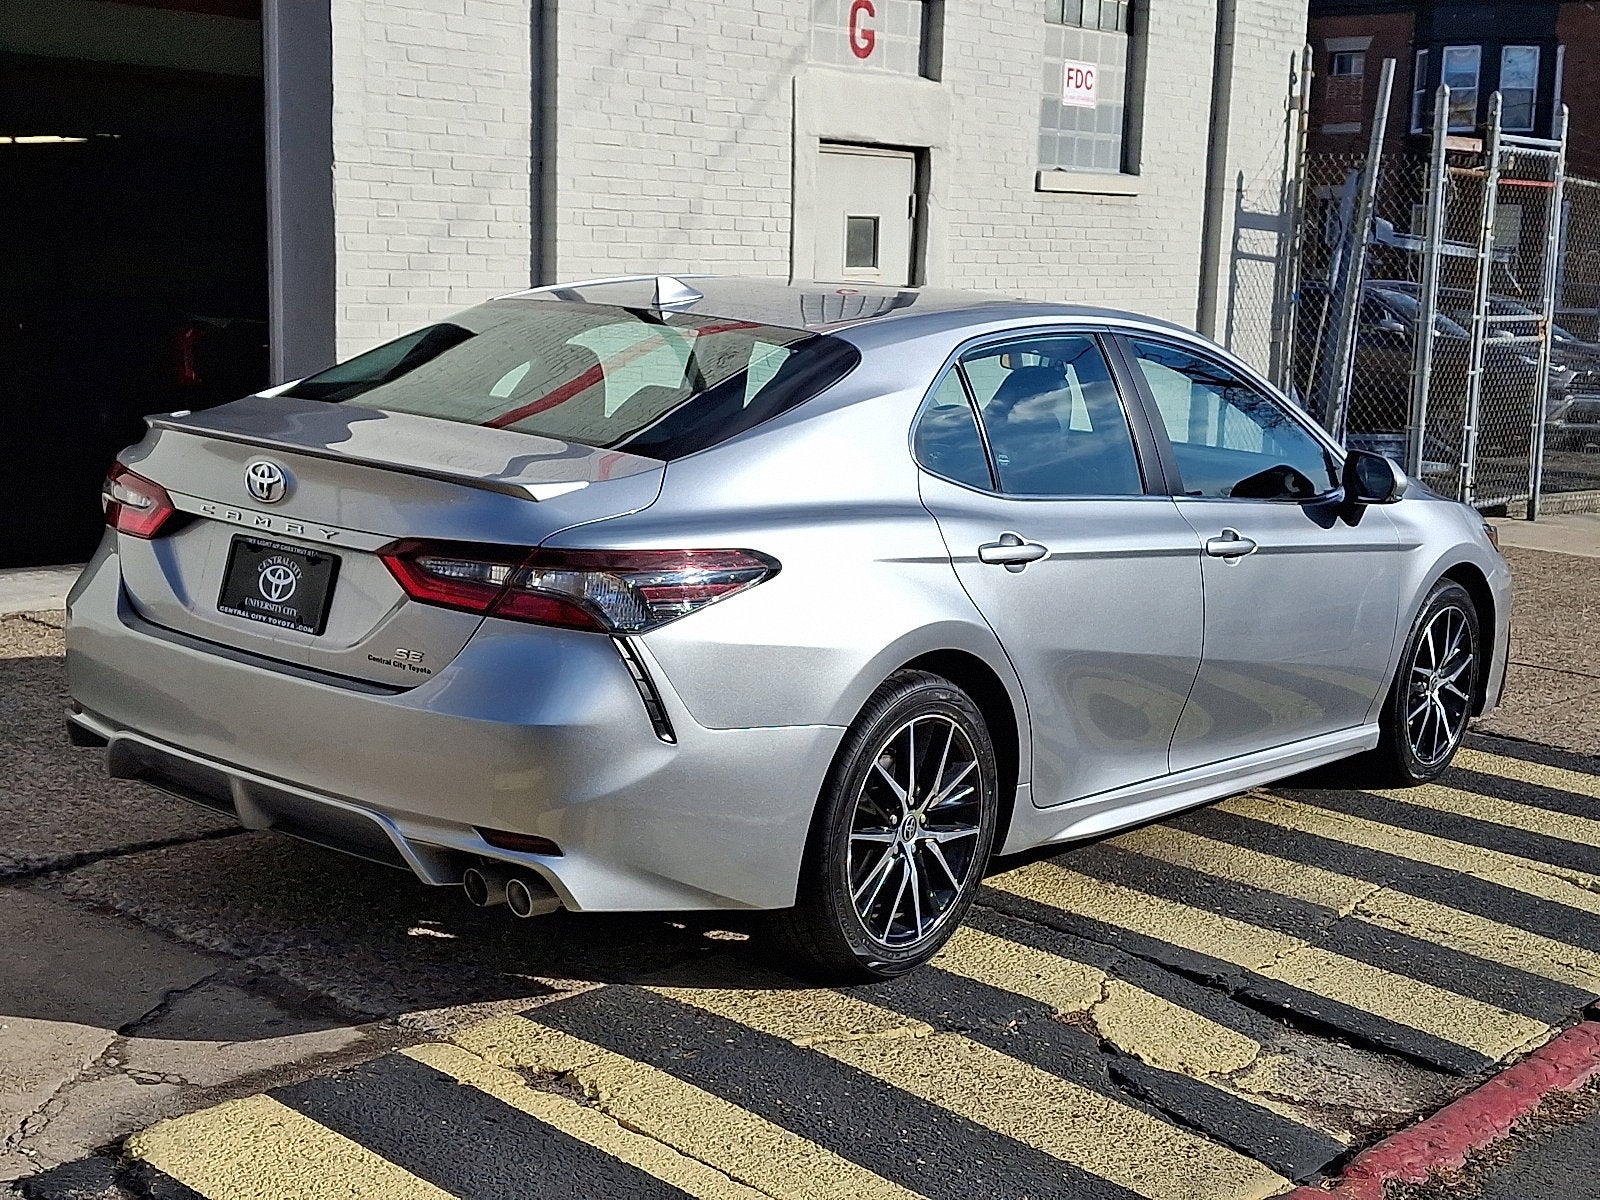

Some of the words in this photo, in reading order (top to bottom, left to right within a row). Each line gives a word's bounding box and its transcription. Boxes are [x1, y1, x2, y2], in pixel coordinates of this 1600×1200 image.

[849, 0, 876, 59] G
[1066, 67, 1094, 91] FDC
[200, 503, 340, 540] CAMRY
[257, 555, 290, 572] CENTRAL
[289, 560, 304, 580] CITY
[219, 605, 249, 618] CENTRAL
[250, 613, 267, 623] CITY
[244, 597, 281, 614] UNIVERSITY
[282, 605, 298, 617] CITY
[367, 653, 392, 666] Central
[392, 660, 407, 671] City
[407, 663, 432, 675] Toyota
[393, 647, 425, 663] SE
